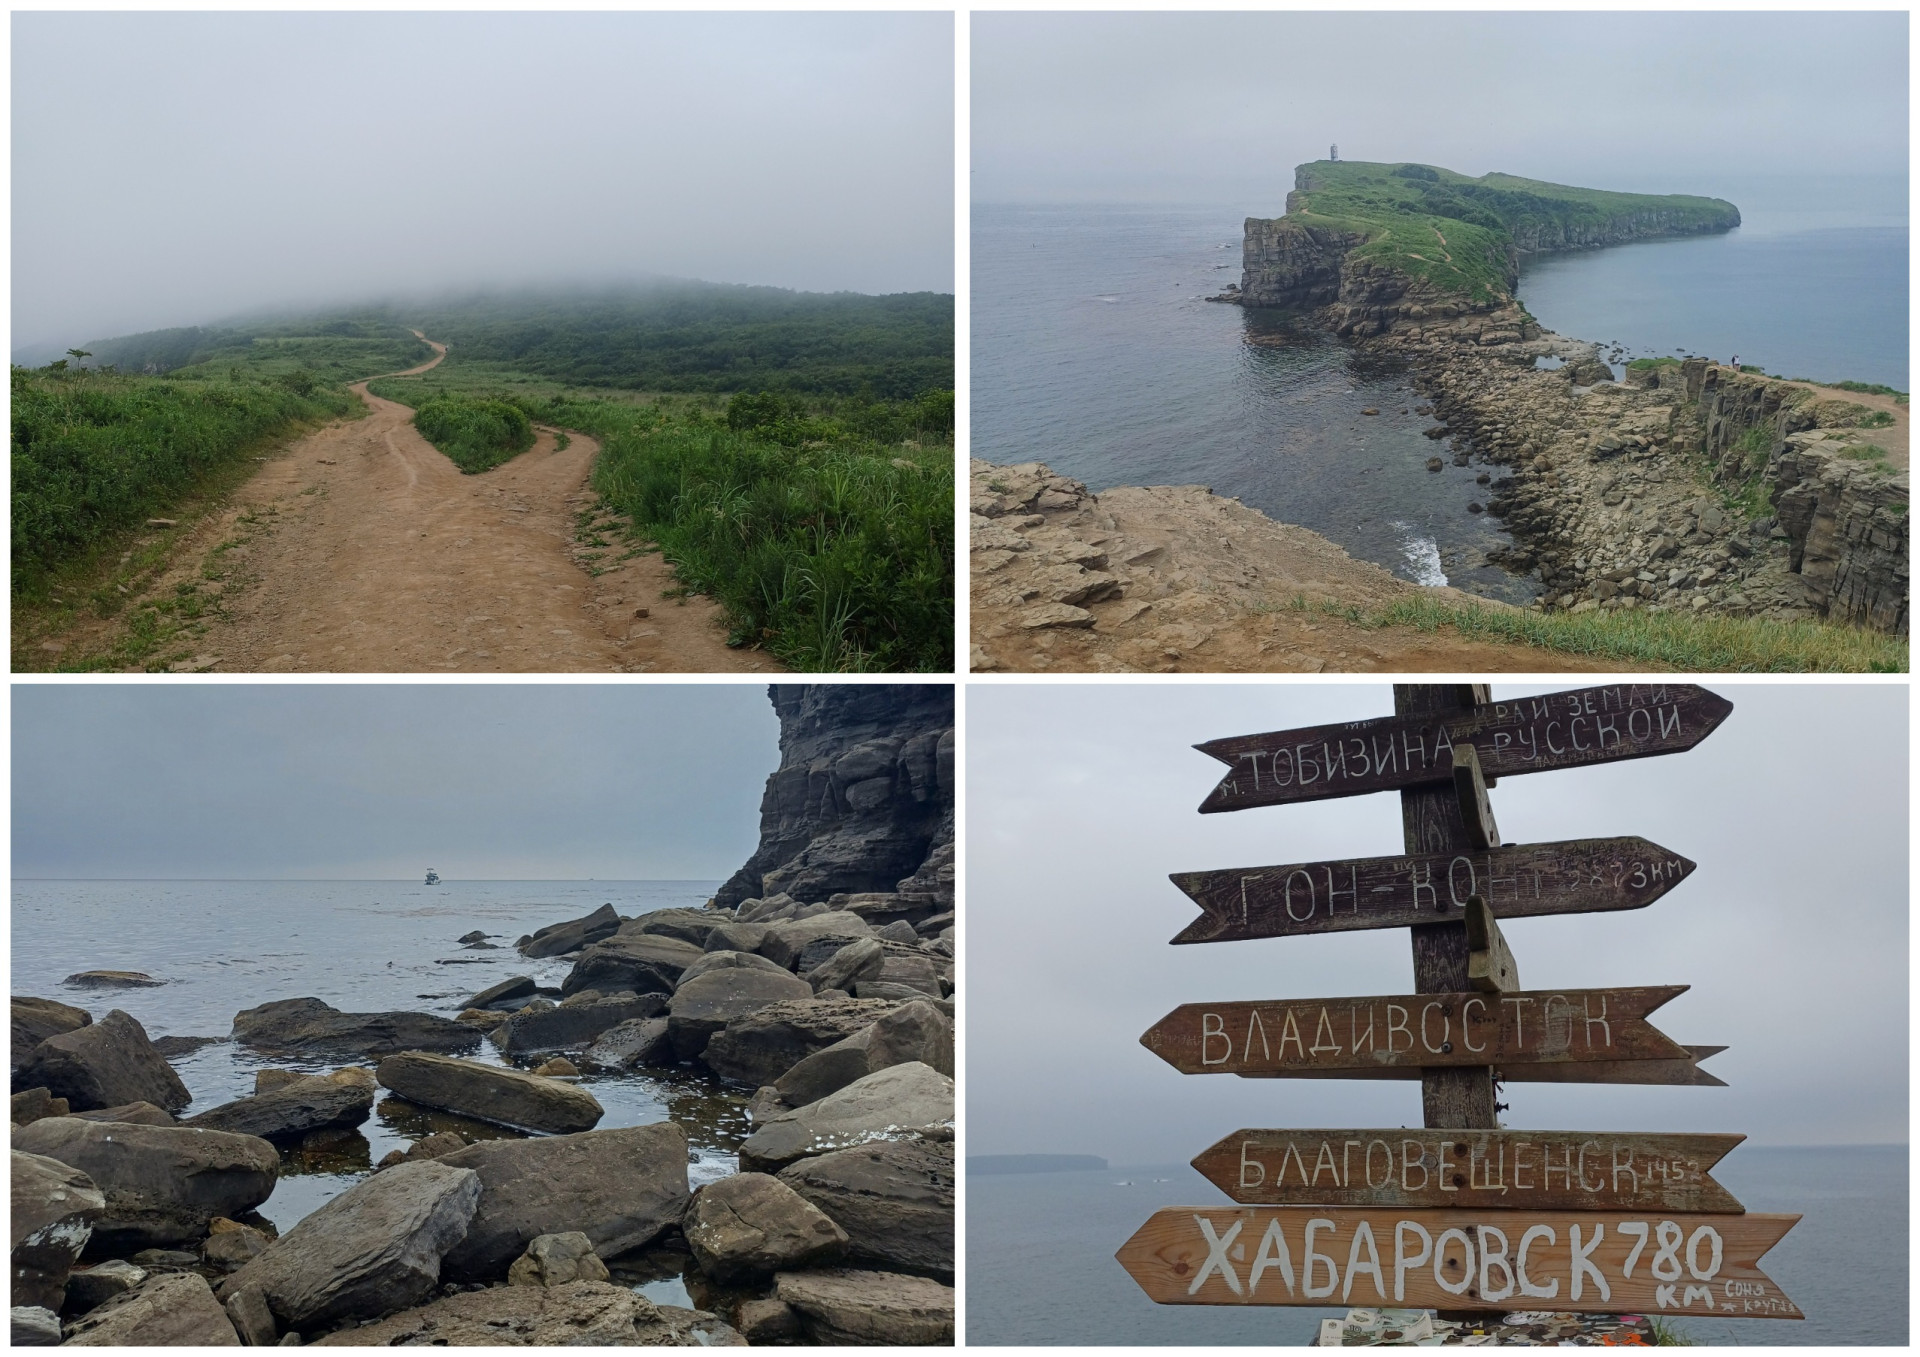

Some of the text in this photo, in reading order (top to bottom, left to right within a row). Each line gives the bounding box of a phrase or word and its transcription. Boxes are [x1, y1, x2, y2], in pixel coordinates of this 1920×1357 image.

[1568, 683, 1667, 717] ЗЕМЛИ
[1239, 724, 1454, 792] ТОБИЗИНА
[1202, 994, 1611, 1066] ВЛАДИВОСТОК
[1239, 1138, 1700, 1193] БЛАГОВЕЩЕНСК 1452
[1188, 1214, 1723, 1302] ХАБАРОВСК 780
